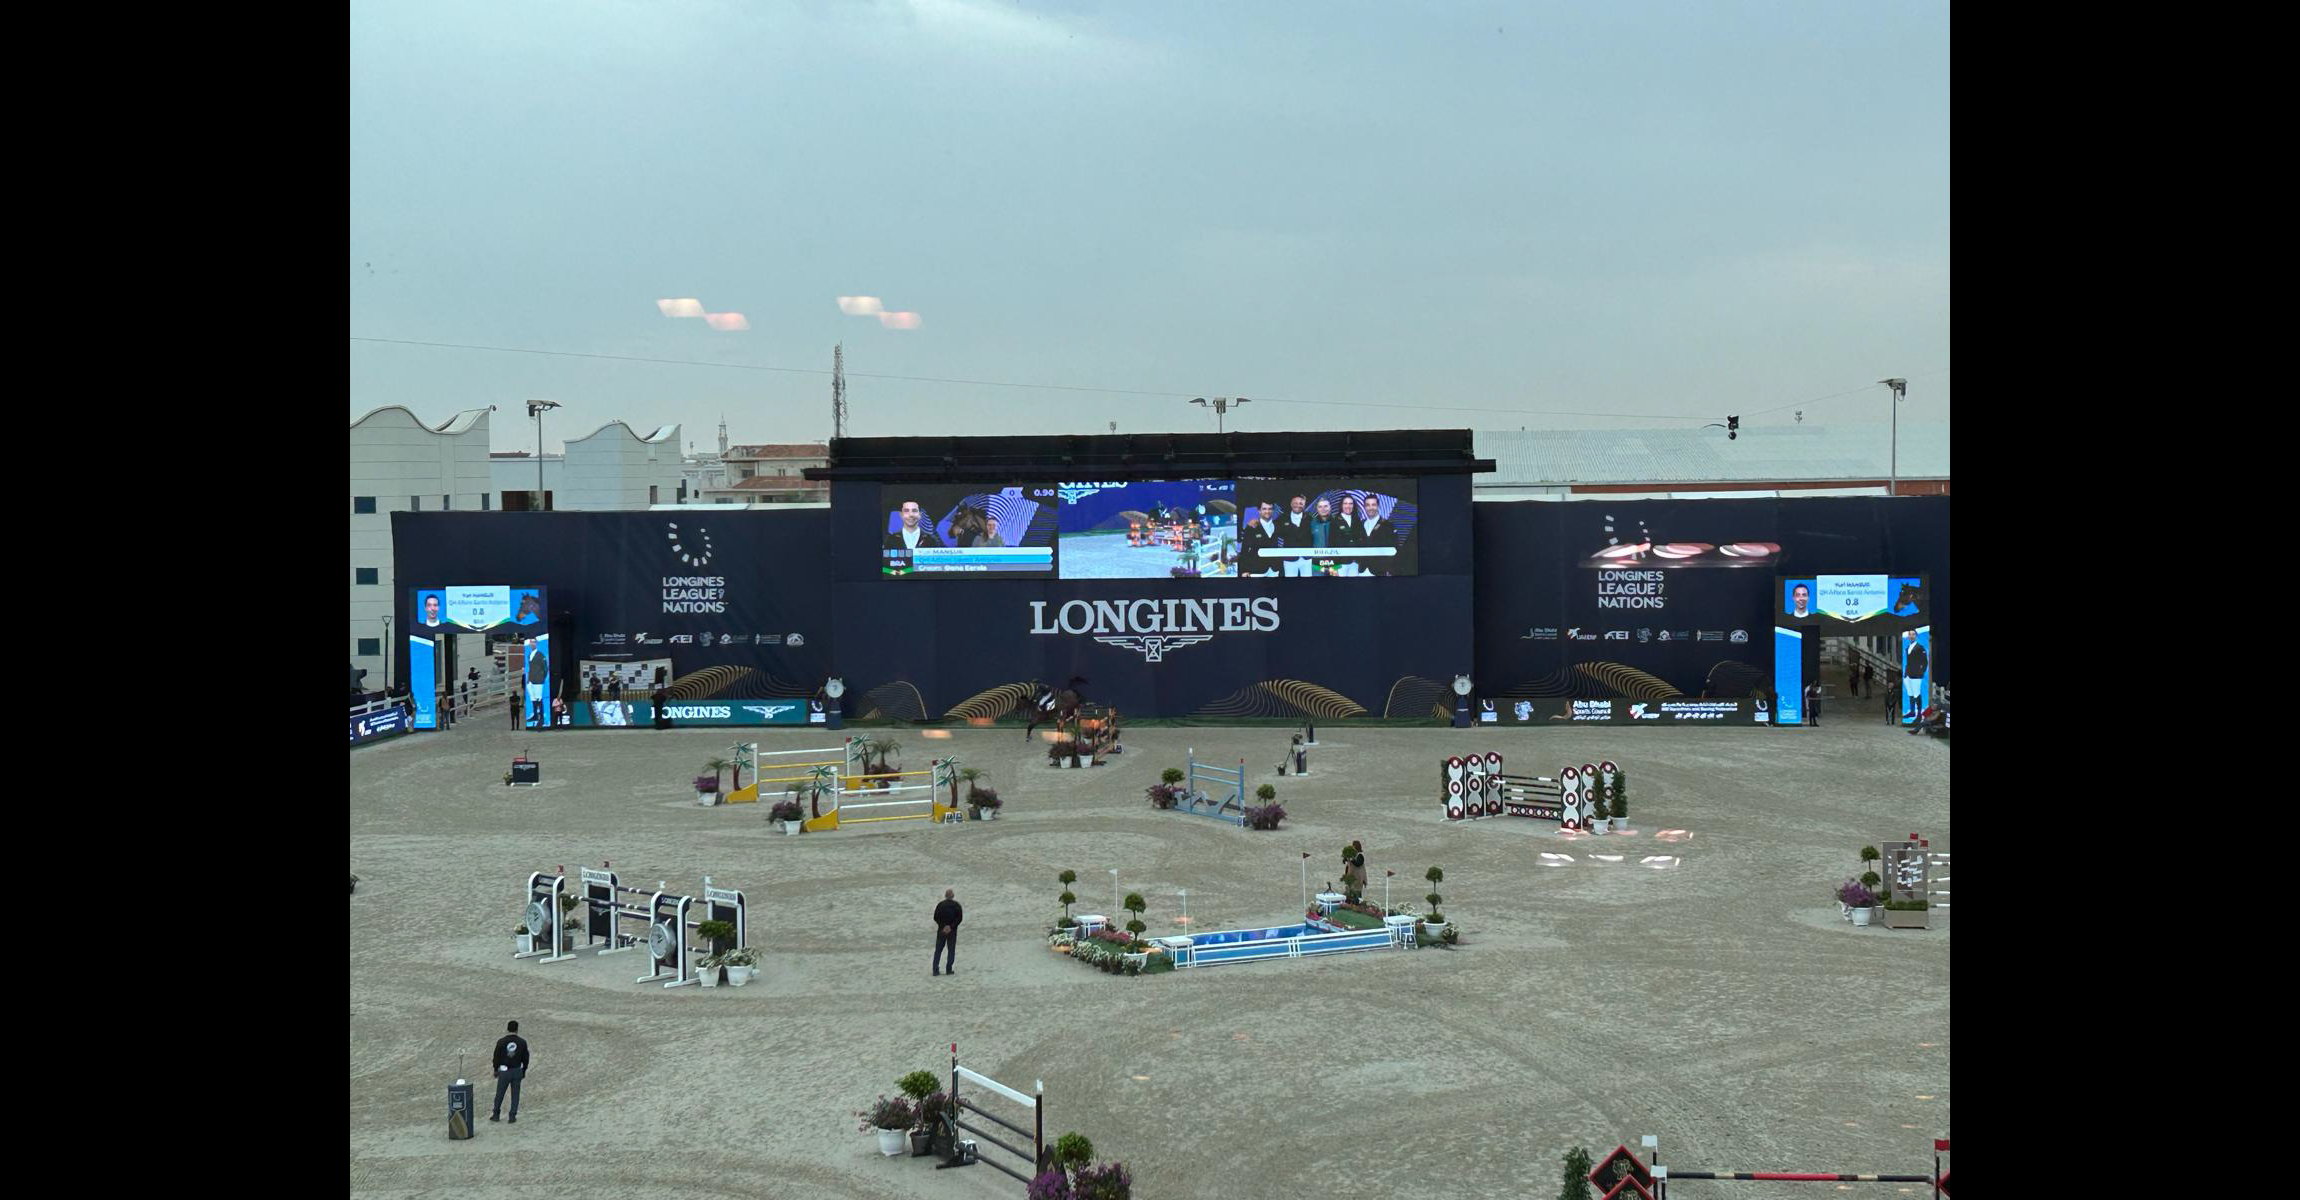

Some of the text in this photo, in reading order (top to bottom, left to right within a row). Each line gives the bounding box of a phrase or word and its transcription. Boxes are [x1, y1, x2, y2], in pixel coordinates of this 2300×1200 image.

[663, 576, 725, 587] LONGINES
[1598, 571, 1664, 581] LONGINES
[662, 588, 717, 600] LEAGUE
[1598, 583, 1656, 595] LEAGUE
[662, 601, 726, 613] NATIONS
[1598, 597, 1665, 609] NATIONS
[1029, 597, 1280, 635] LONGINES
[1573, 700, 1611, 708] Abu Dhabi
